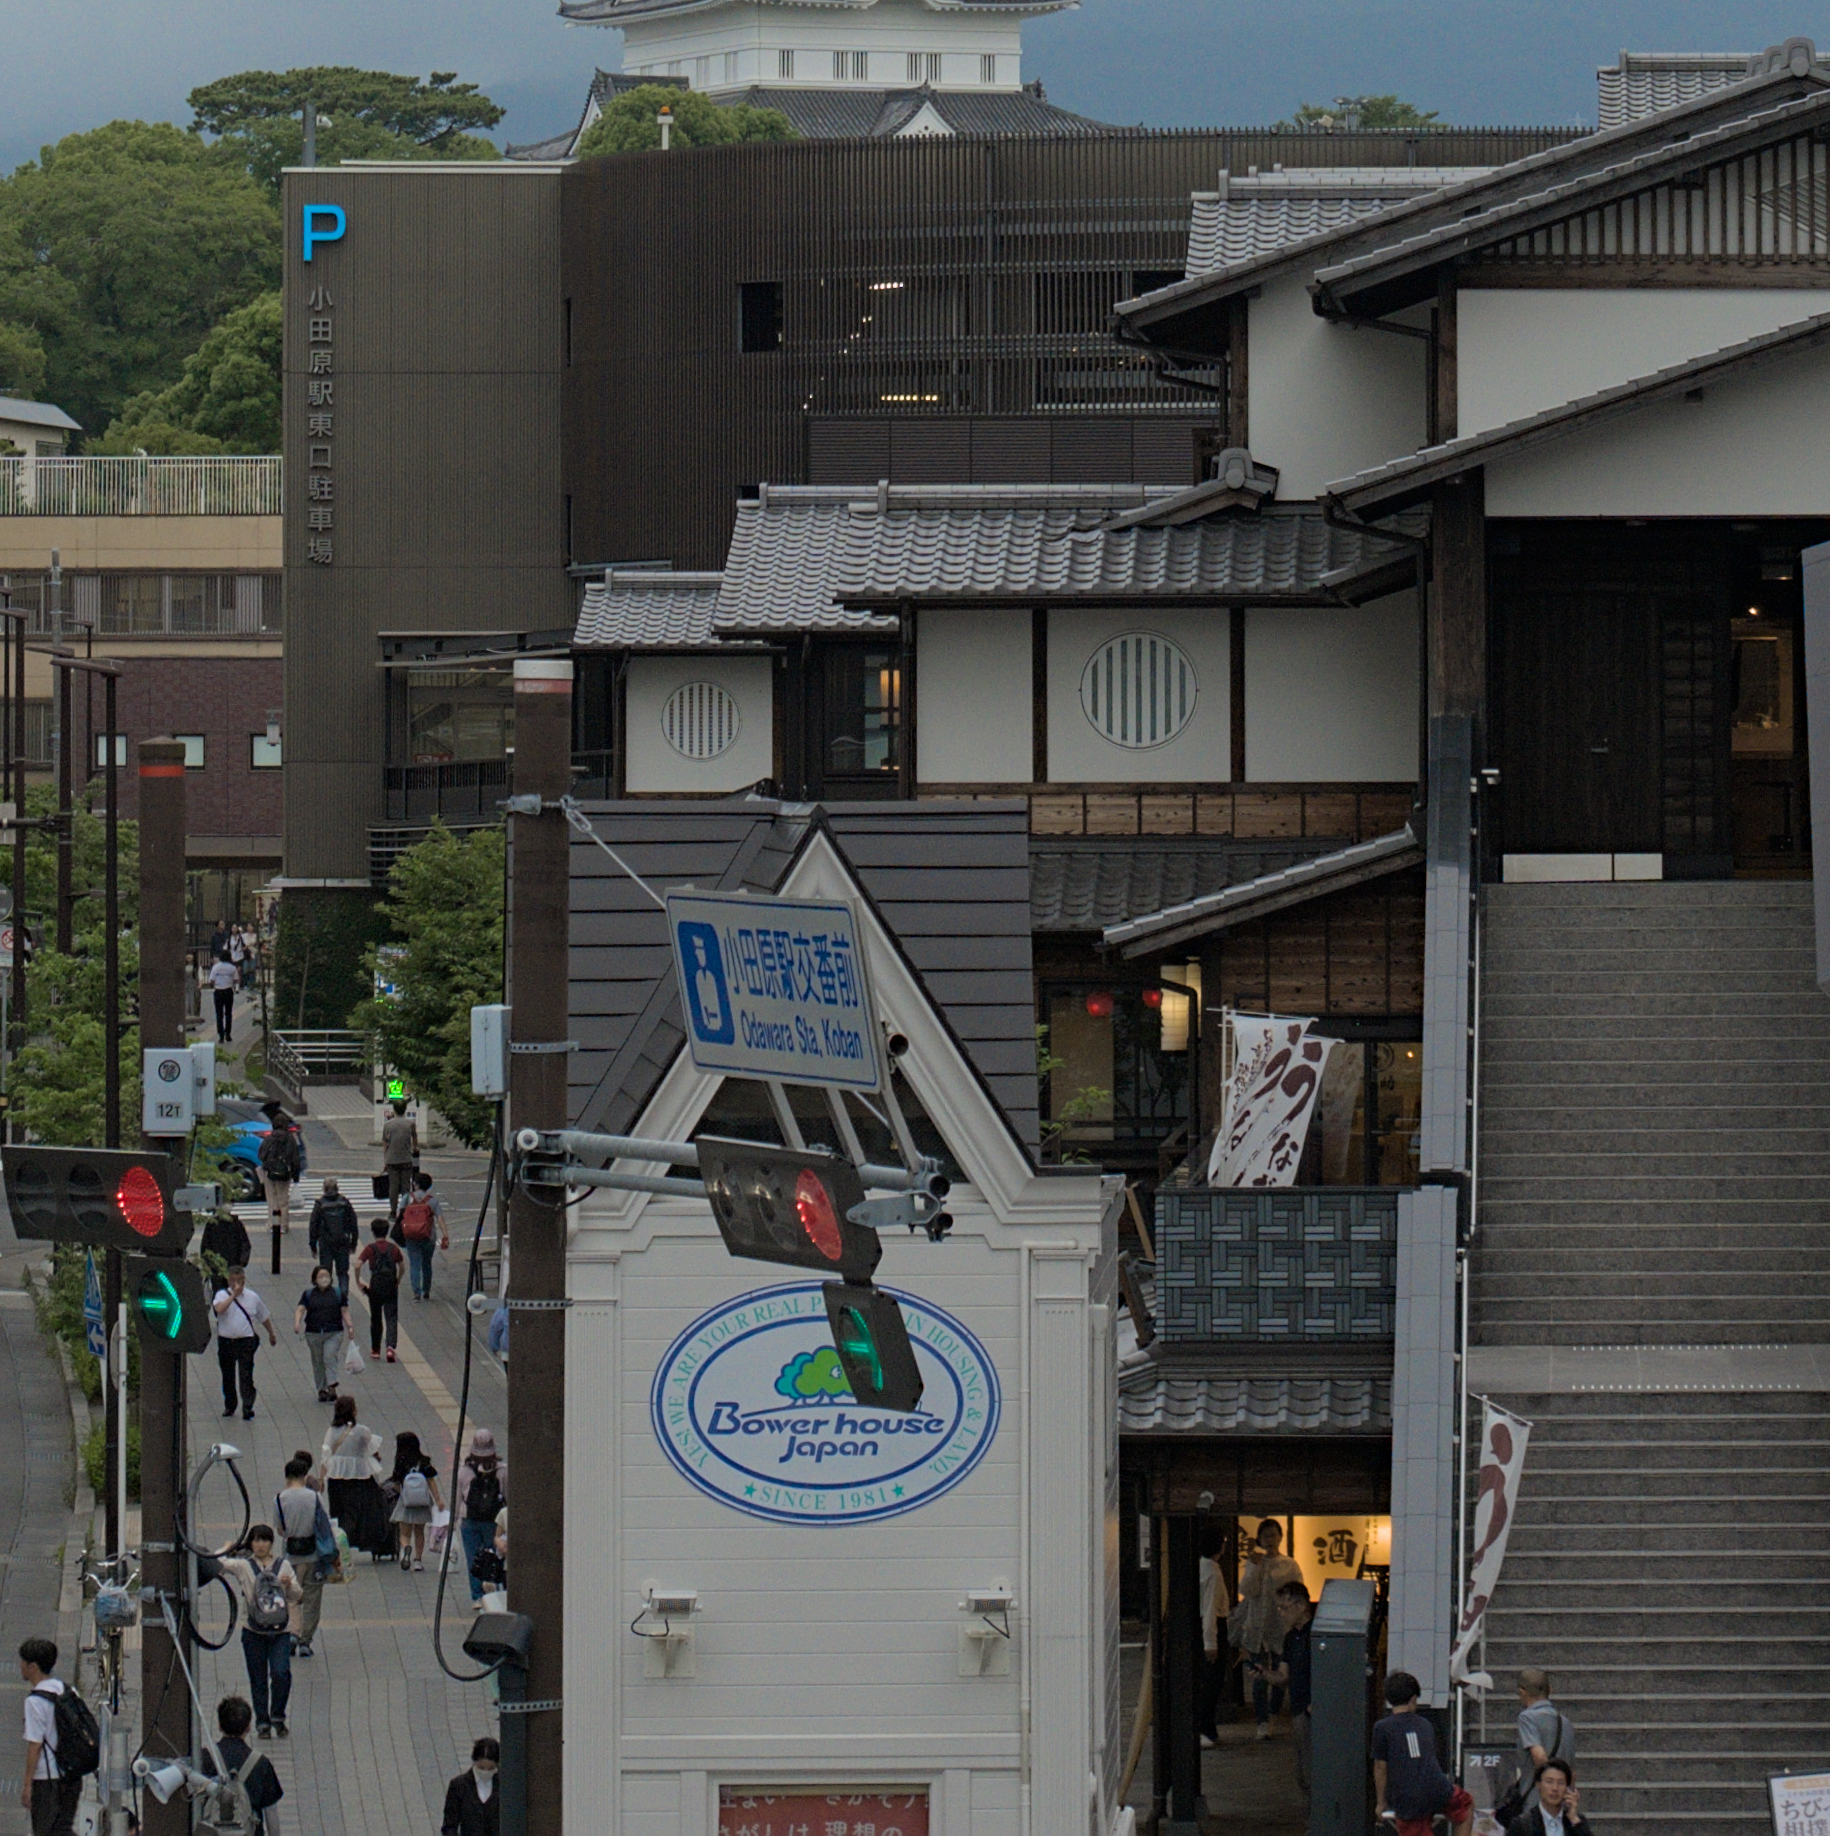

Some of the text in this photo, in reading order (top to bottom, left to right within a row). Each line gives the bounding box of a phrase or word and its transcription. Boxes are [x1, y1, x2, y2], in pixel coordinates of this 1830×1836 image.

[303, 204, 347, 262] P
[307, 285, 334, 565] 小田原駅東口駐車場
[724, 926, 859, 1008] 小田原駅交番前
[740, 1010, 795, 1054] Odawara
[823, 1021, 863, 1062] Koban
[158, 1105, 181, 1118] 12T
[753, 1295, 806, 1323] REAL
[700, 1313, 750, 1352] YOUR
[673, 1347, 704, 1390] ARE
[926, 1322, 983, 1403] HOUSING
[667, 1396, 686, 1427] WE
[707, 1401, 945, 1437] Bower house
[779, 1435, 879, 1464] Japan
[760, 1482, 889, 1513] SINCE 1981
[1313, 1529, 1357, 1568] 酒
[1483, 1755, 1501, 1768] 2F
